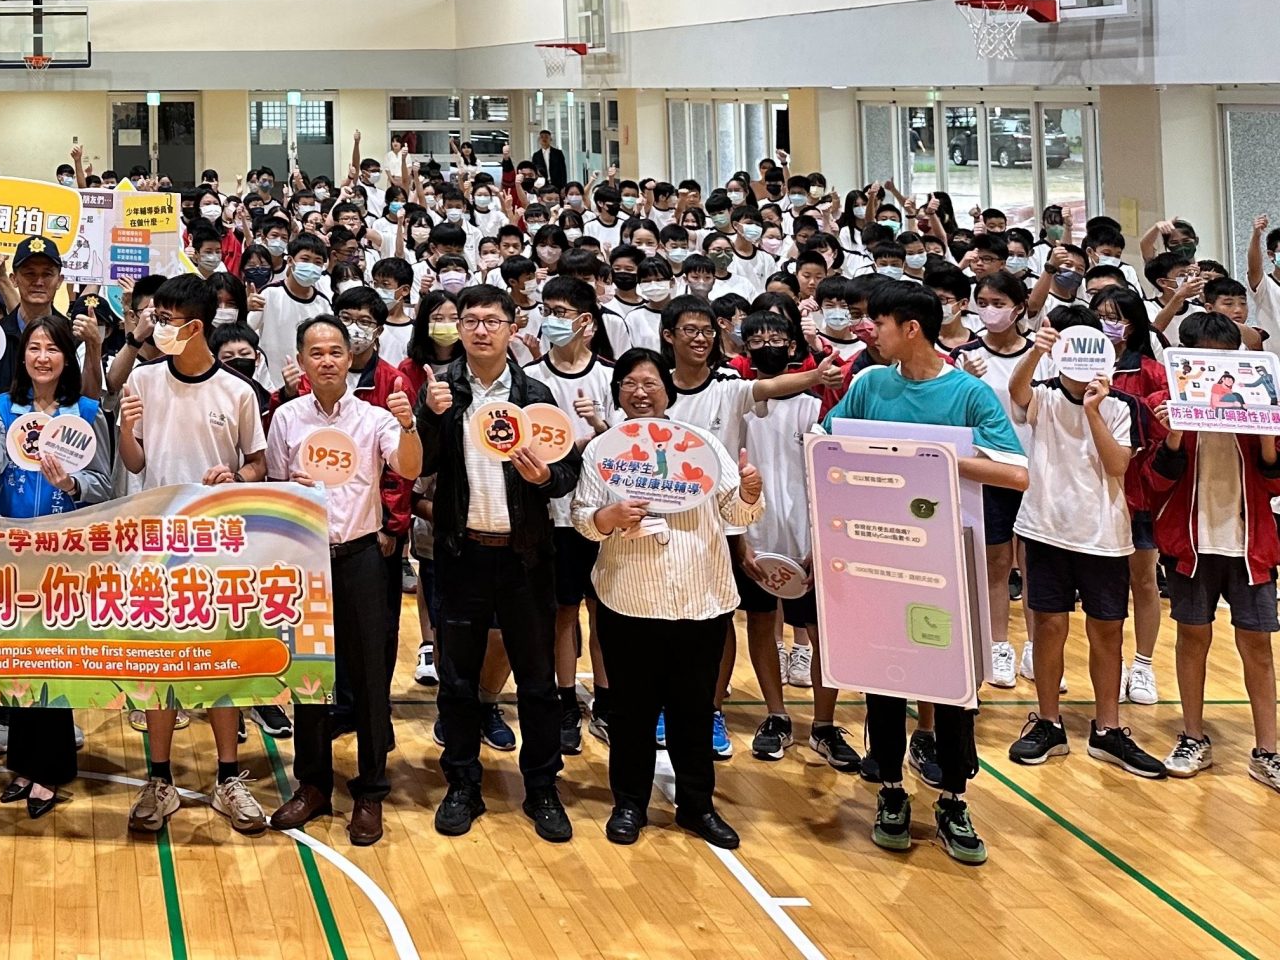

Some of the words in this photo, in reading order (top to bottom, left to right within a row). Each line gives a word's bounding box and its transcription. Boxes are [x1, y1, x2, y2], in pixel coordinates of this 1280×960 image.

[489, 410, 509, 419] 165
[21, 420, 39, 432] 165
[532, 423, 567, 446] 953
[308, 444, 352, 469] 1953
[601, 458, 653, 474] 強化學生
[610, 474, 701, 495] 身心健康與輔導
[35, 646, 64, 655] week
[67, 646, 76, 655] in
[80, 646, 98, 656] the
[101, 646, 123, 656] first
[126, 647, 175, 657] semester
[179, 647, 190, 657] of
[193, 647, 212, 657] the
[12, 658, 72, 669] Prevention
[82, 659, 103, 669] You
[106, 661, 123, 670] are
[126, 660, 159, 673] happy
[162, 660, 183, 671] and
[193, 662, 211, 670] am
[215, 659, 241, 669] safe.
